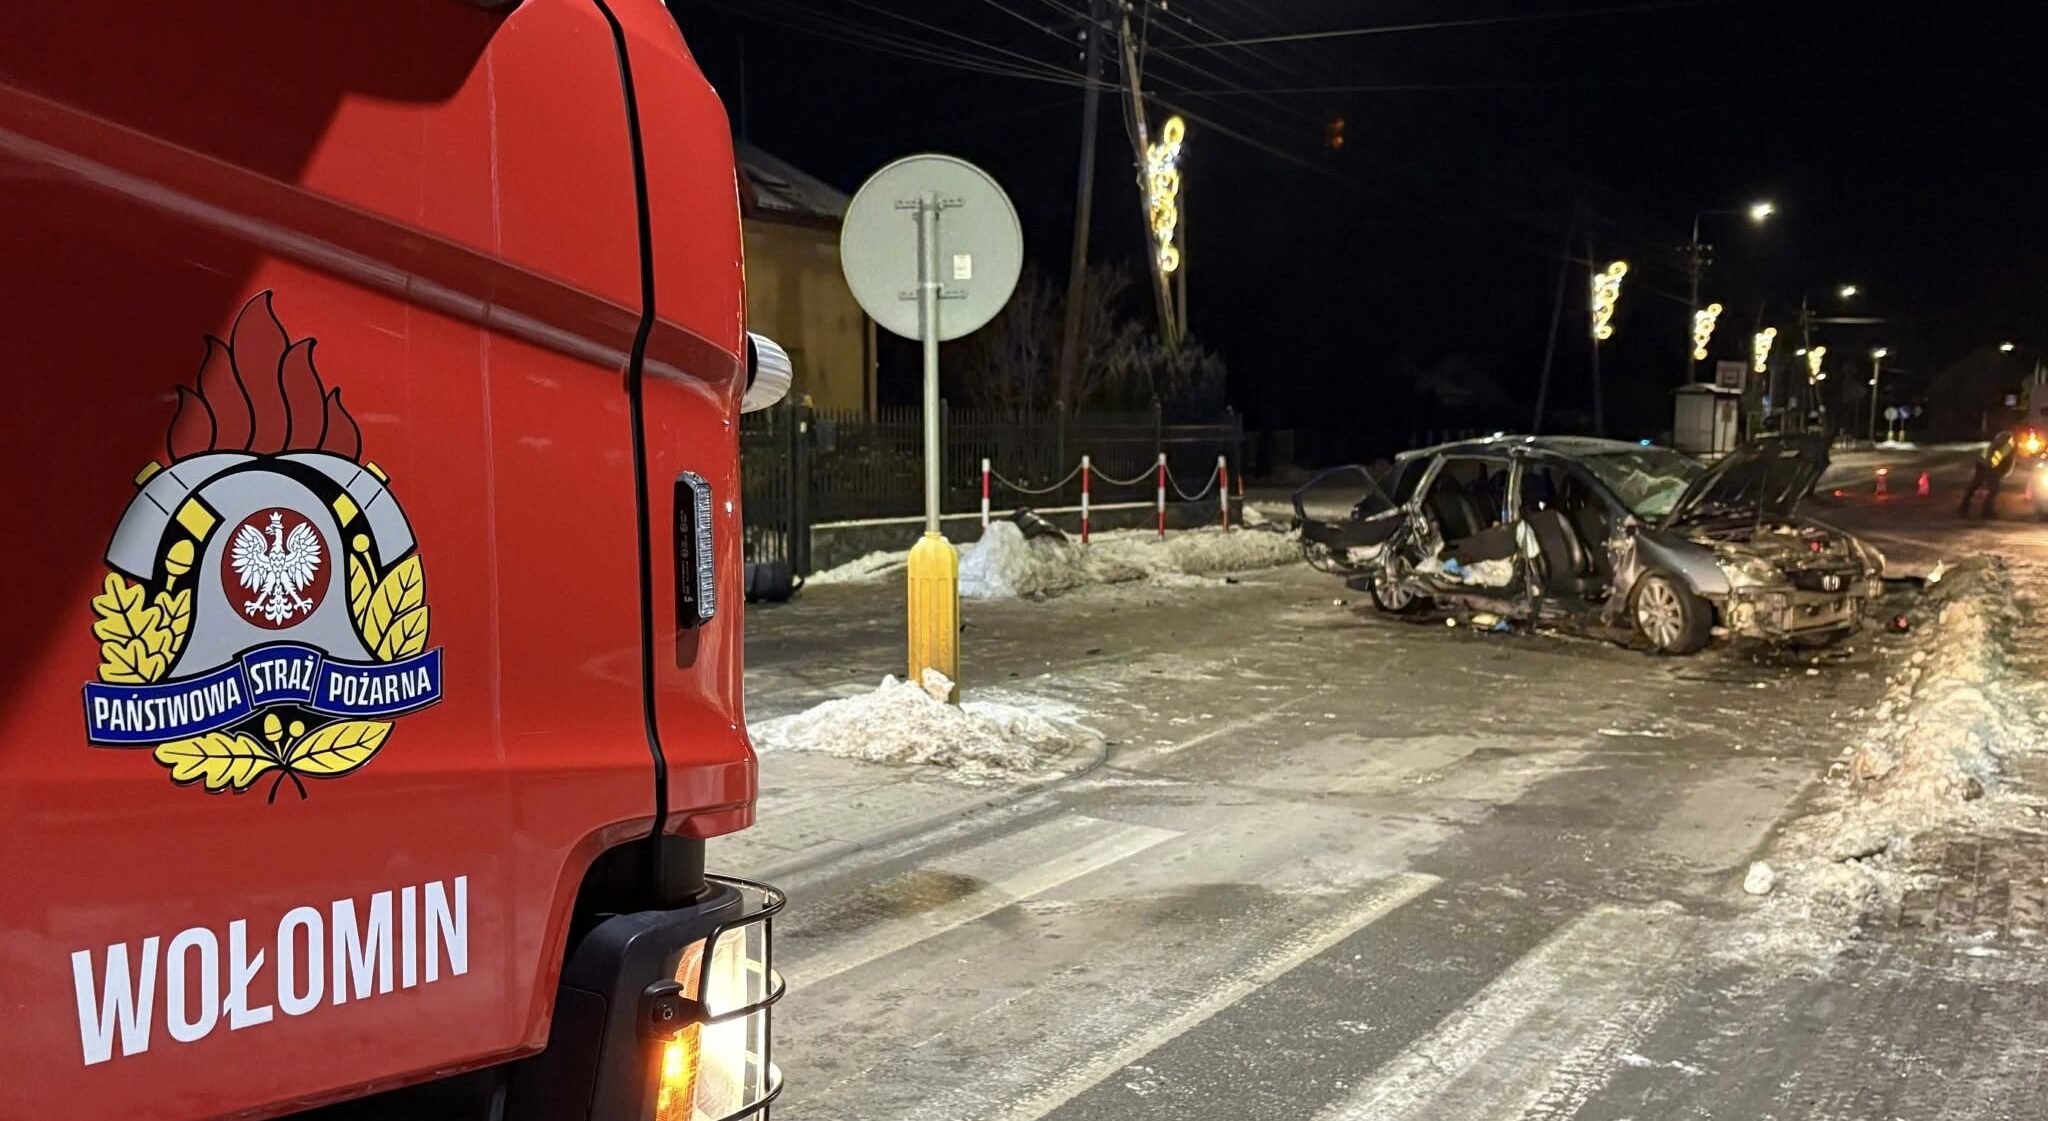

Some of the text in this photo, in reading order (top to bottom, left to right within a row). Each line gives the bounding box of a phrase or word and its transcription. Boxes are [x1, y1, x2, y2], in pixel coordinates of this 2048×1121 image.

[94, 655, 432, 732] PAŃSTWOWA STRAŻ POŻARNA
[71, 875, 468, 1066] WOŁOMIN
